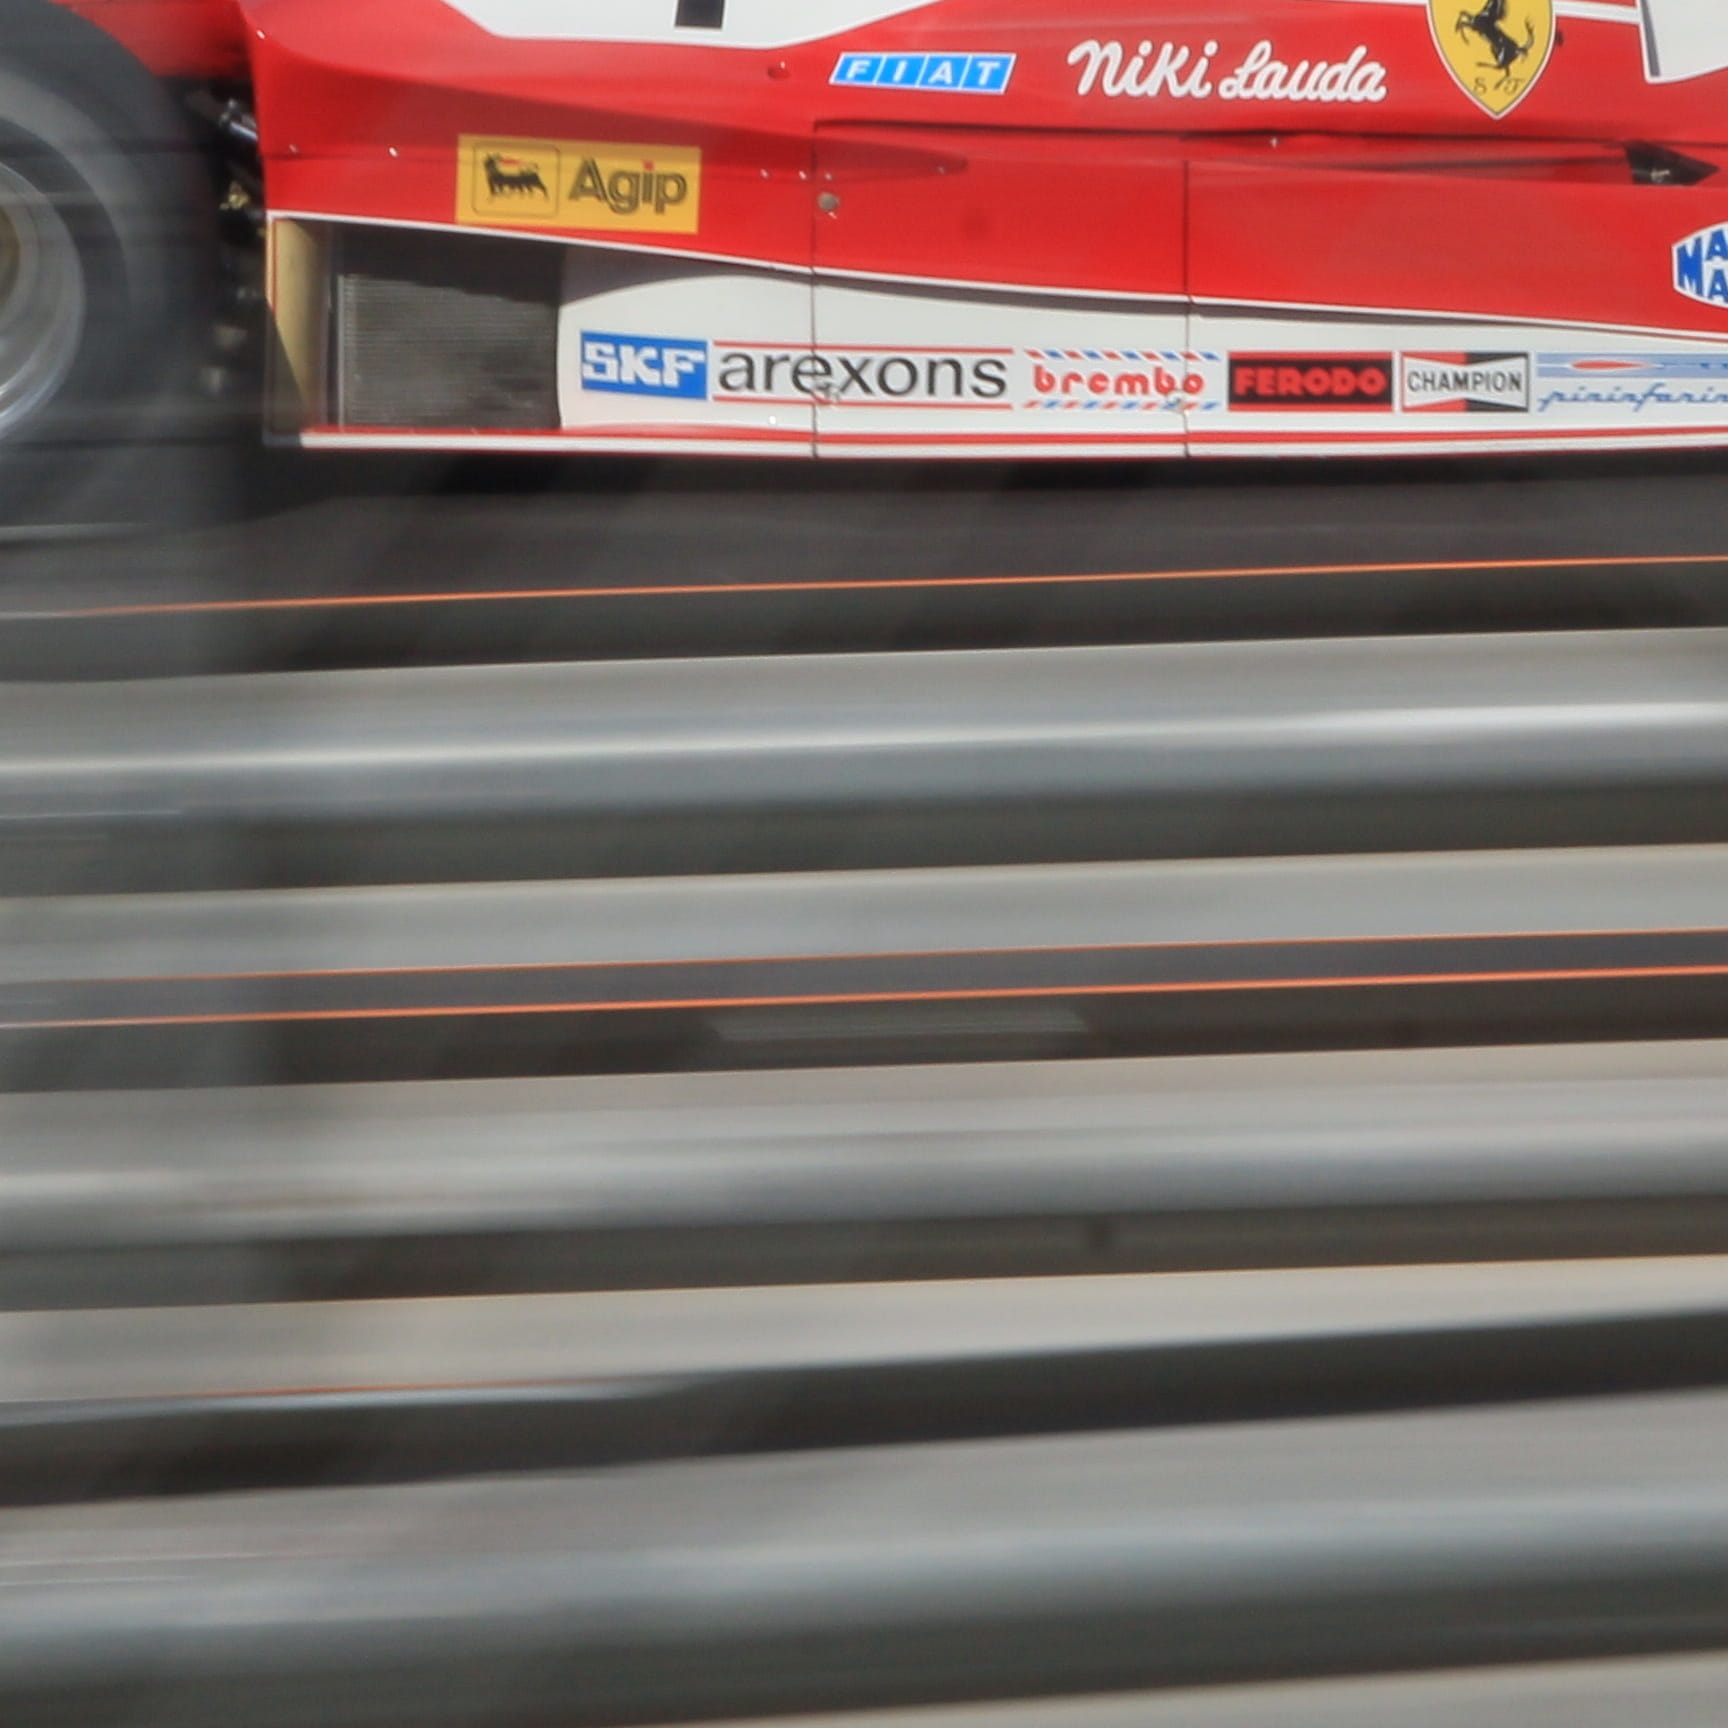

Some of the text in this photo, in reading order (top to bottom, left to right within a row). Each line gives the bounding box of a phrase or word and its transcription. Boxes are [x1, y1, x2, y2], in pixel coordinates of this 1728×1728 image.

[845, 60, 999, 87] FIAT
[1218, 39, 1387, 102] Lauda
[568, 159, 689, 214] Agip
[582, 340, 705, 388] SKF
[718, 348, 1008, 399] arexons
[1032, 364, 1205, 397] brembo
[1232, 363, 1386, 398] FERODO
[1406, 363, 1523, 394] CHAMPION
